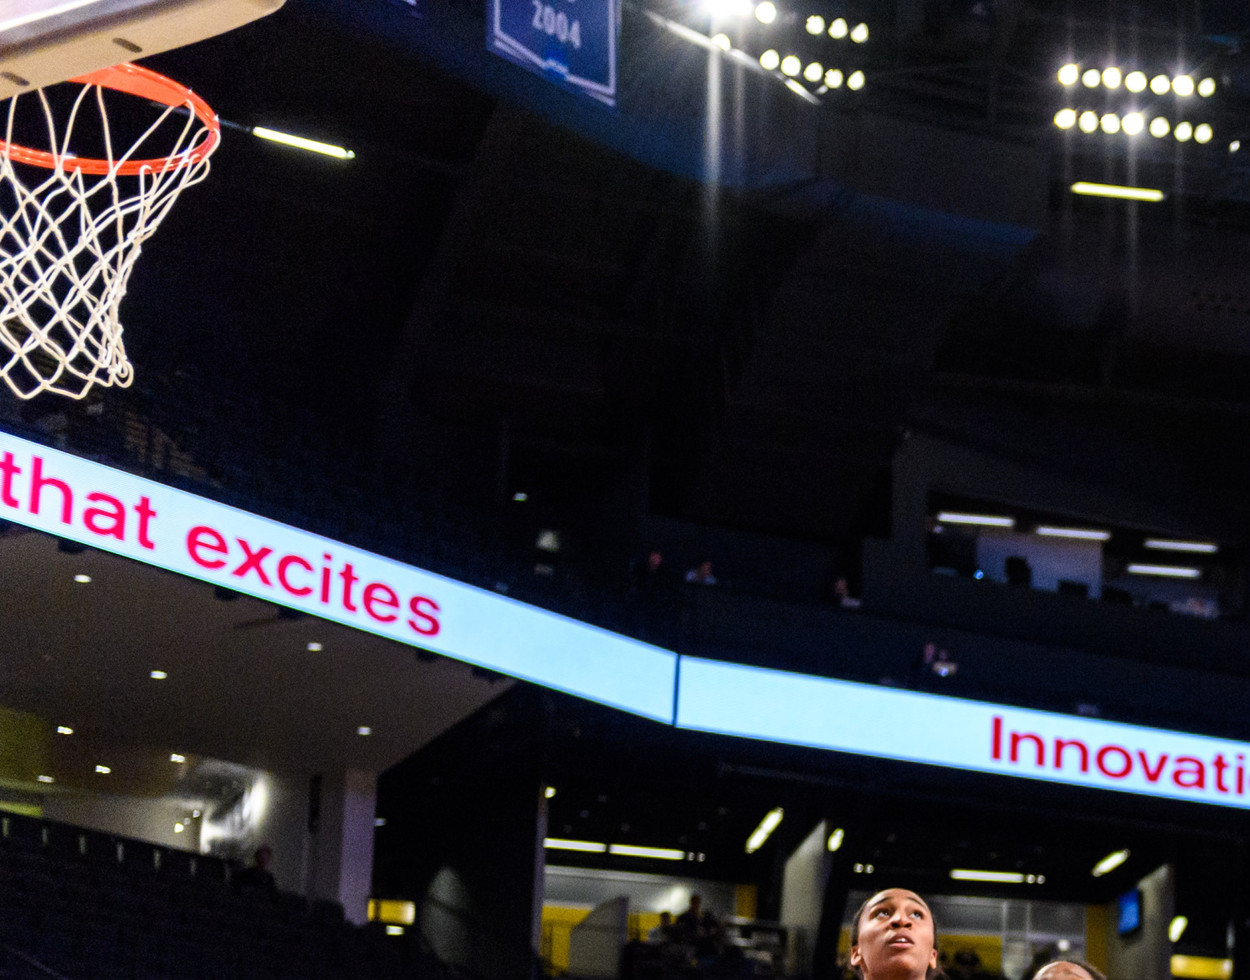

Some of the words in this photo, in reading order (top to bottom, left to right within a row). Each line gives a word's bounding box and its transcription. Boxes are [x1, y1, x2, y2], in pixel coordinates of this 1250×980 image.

[532, 0, 581, 49] 2004
[0, 450, 158, 551] that
[185, 523, 441, 638] excites
